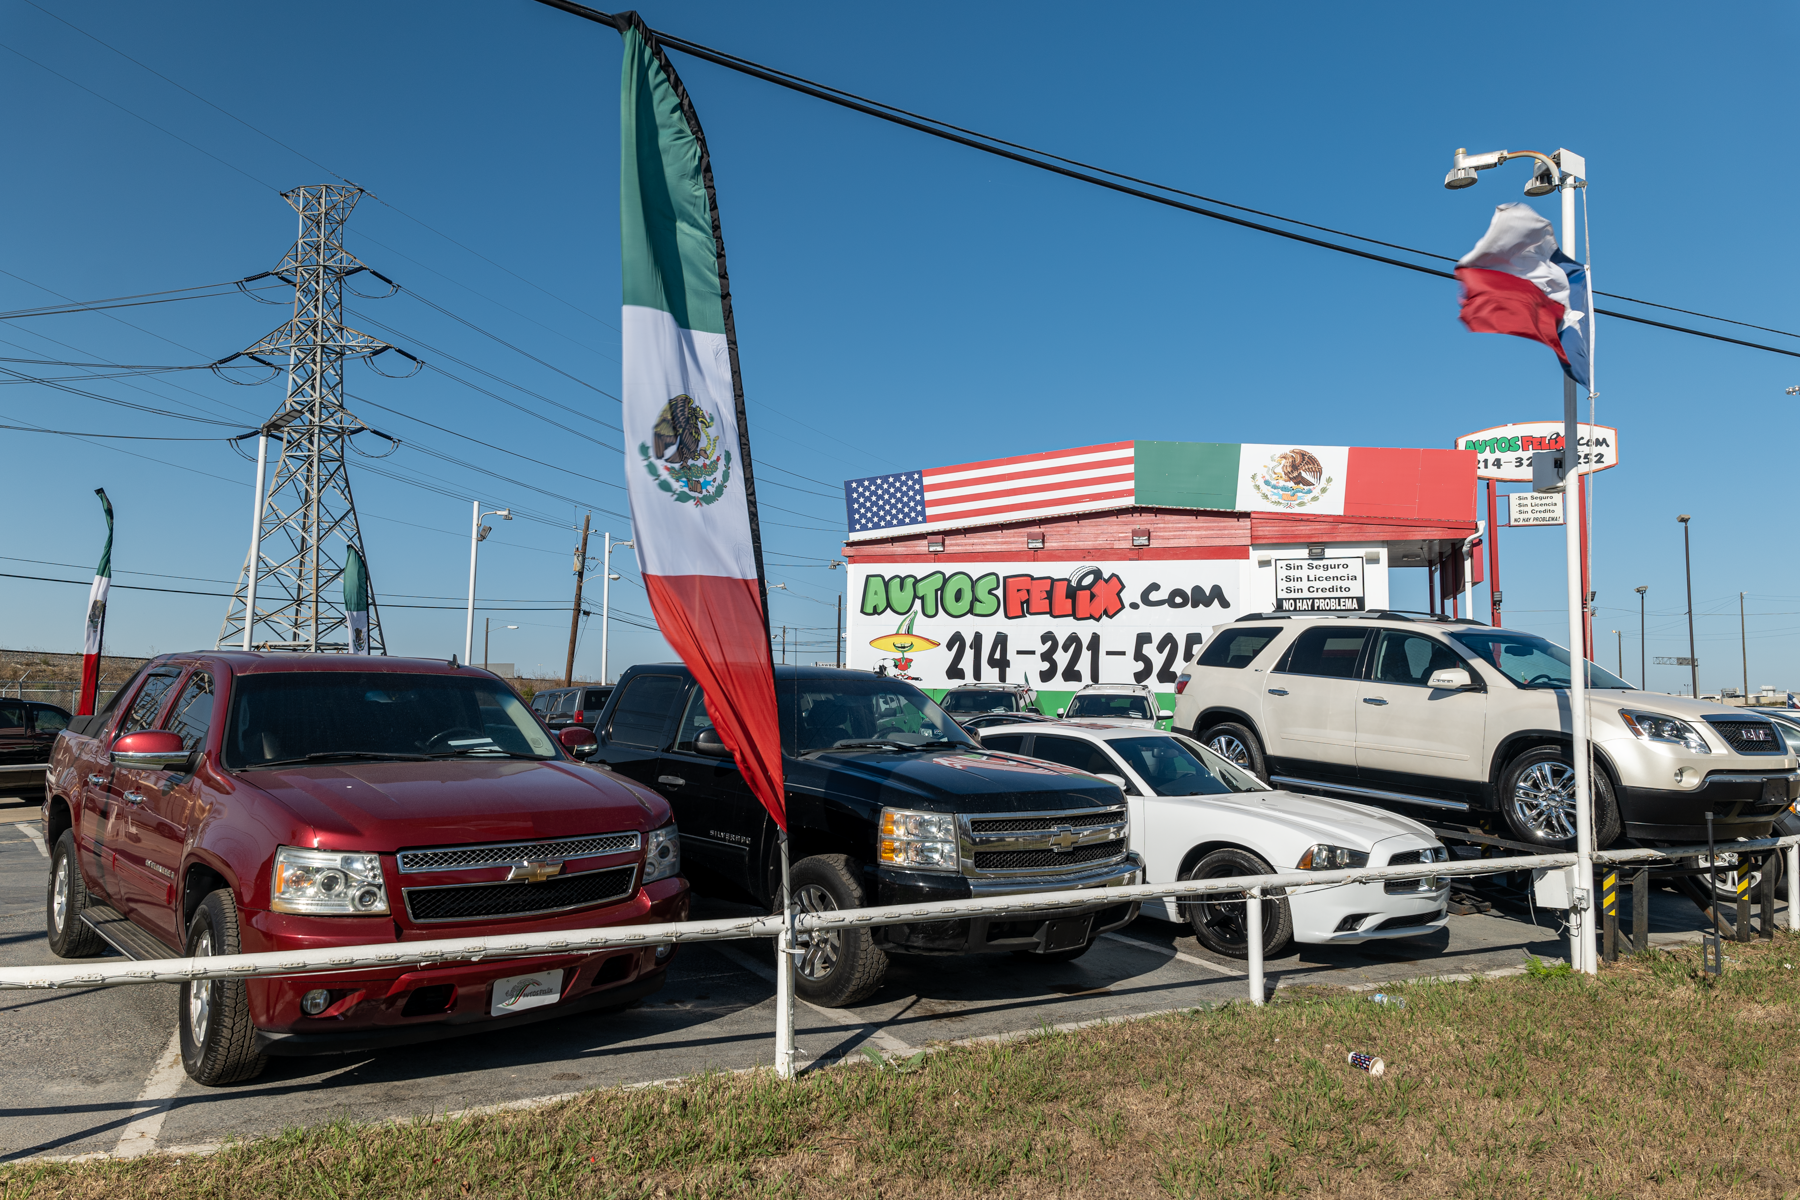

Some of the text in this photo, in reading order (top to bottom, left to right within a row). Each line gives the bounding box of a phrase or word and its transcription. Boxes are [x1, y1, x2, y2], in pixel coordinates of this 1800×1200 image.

[1465, 436, 1520, 454] AUTOS
[1285, 562, 1349, 571] Sin Seguro
[1307, 574, 1357, 582] Licencia
[860, 571, 1000, 618] AUTOS
[1285, 585, 1351, 594] Sin Credito
[1282, 598, 1358, 610] NO HAY PROBLEMA
